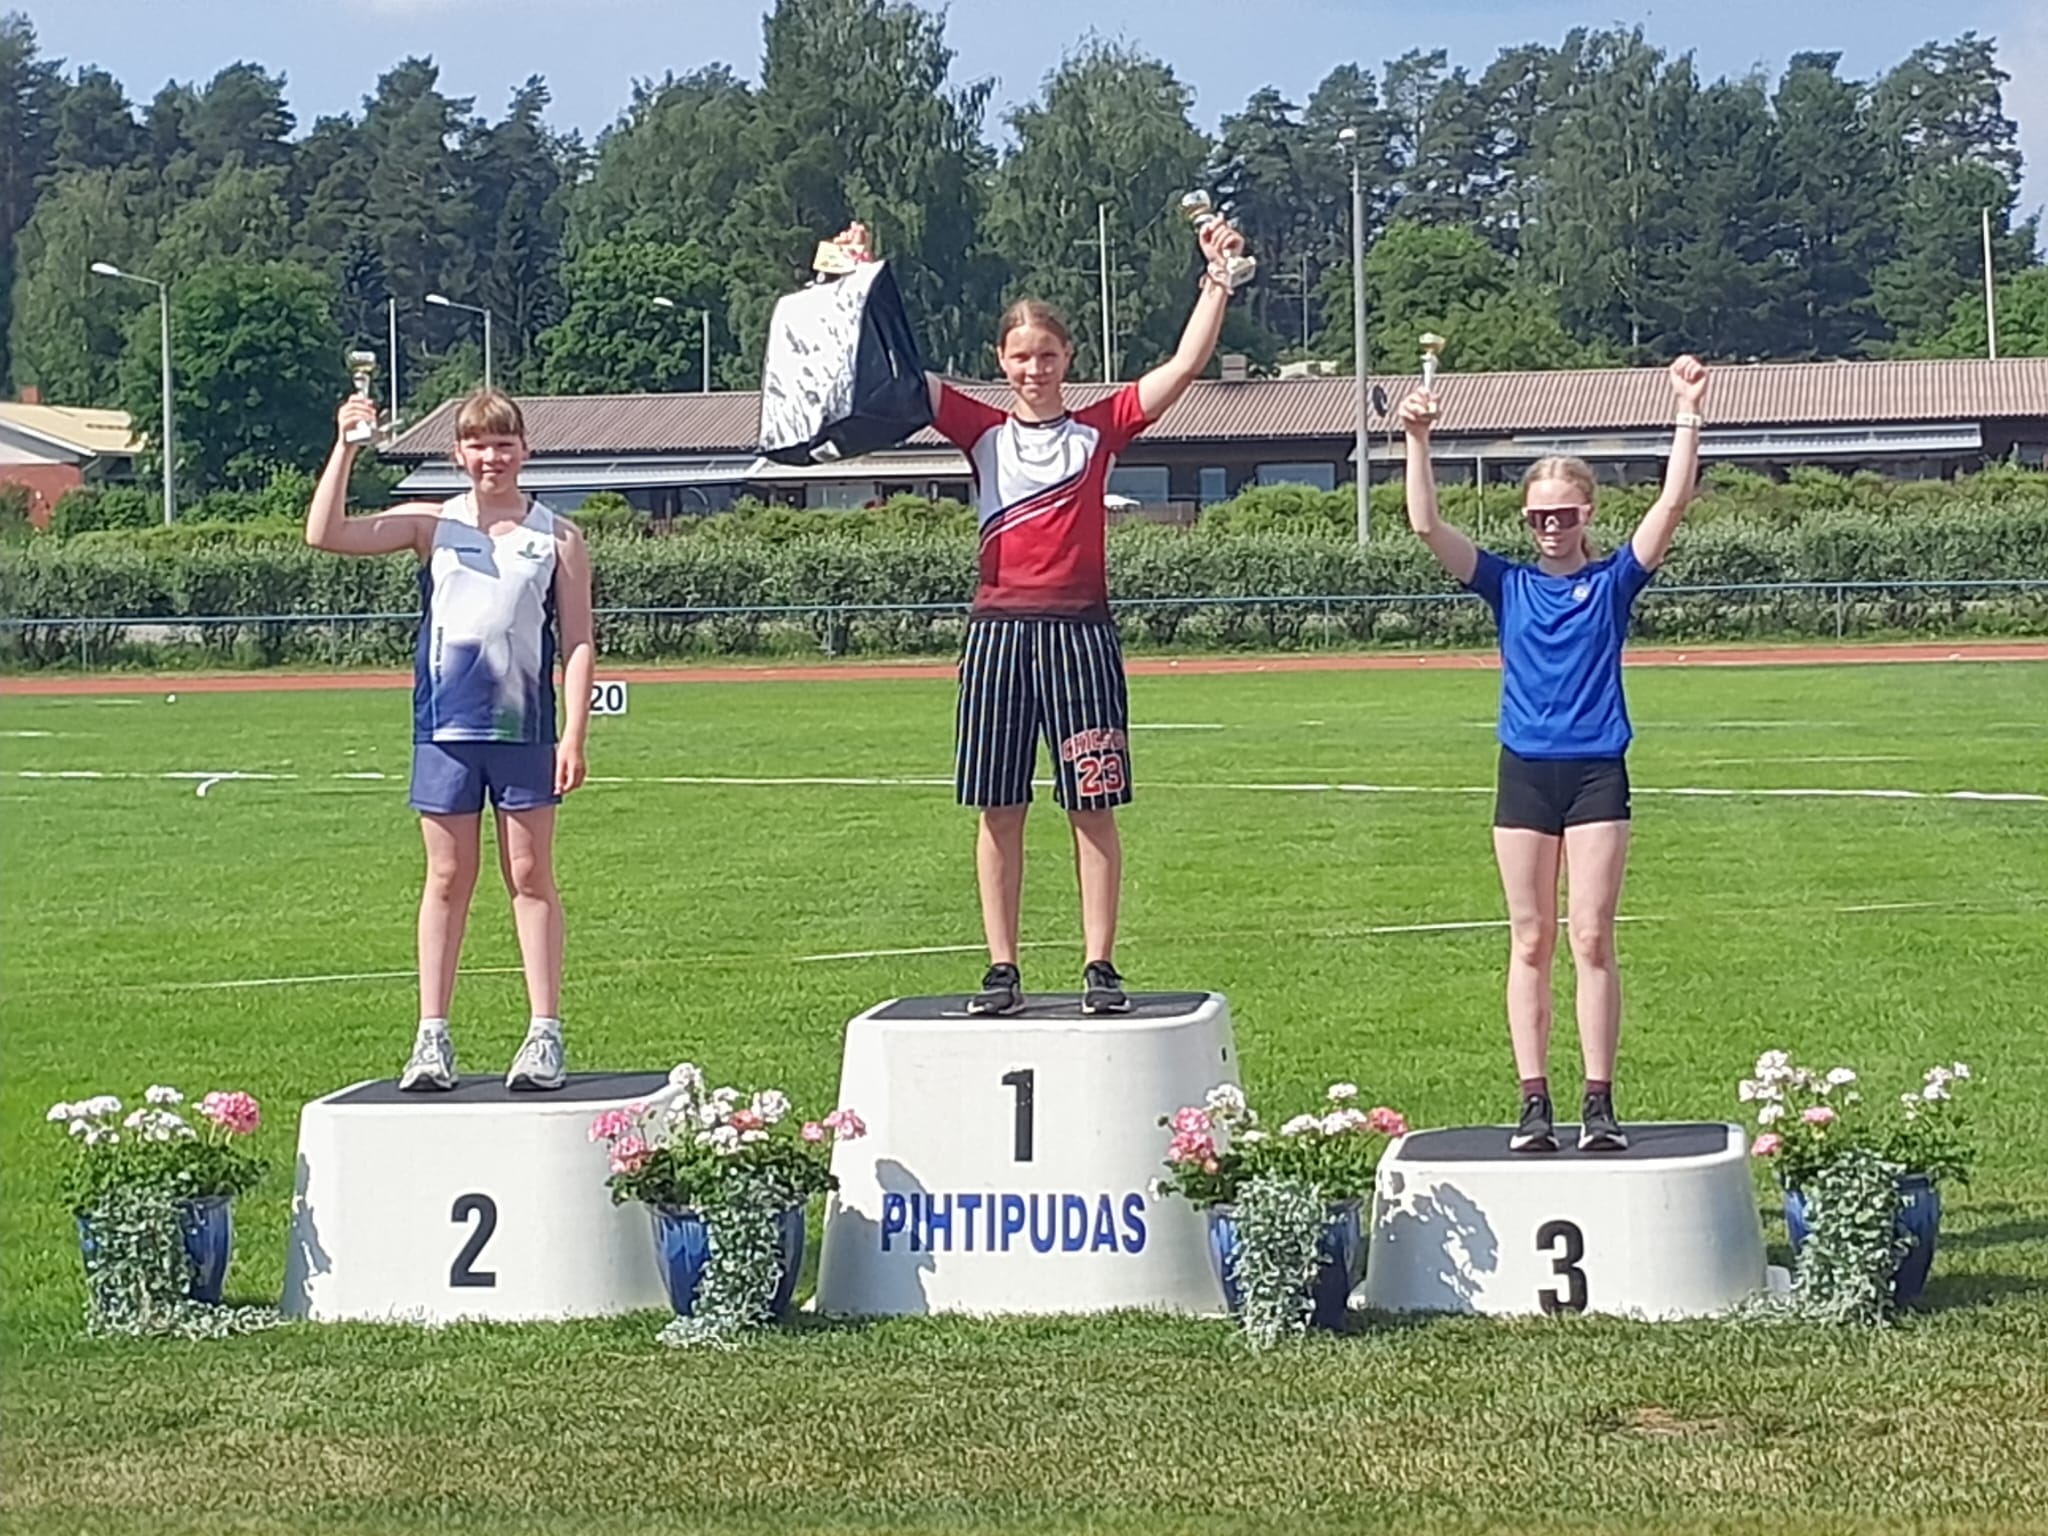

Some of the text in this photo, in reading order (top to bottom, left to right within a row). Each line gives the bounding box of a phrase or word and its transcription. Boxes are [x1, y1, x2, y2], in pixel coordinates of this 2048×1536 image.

[590, 684, 624, 712] 20
[1062, 727, 1126, 762] CHIC
[1078, 753, 1125, 797] 23
[1001, 1068, 1034, 1162] 1
[449, 1192, 498, 1288] 2
[881, 1193, 1147, 1254] PIHTIPUDAS
[1536, 1219, 1588, 1316] 3
